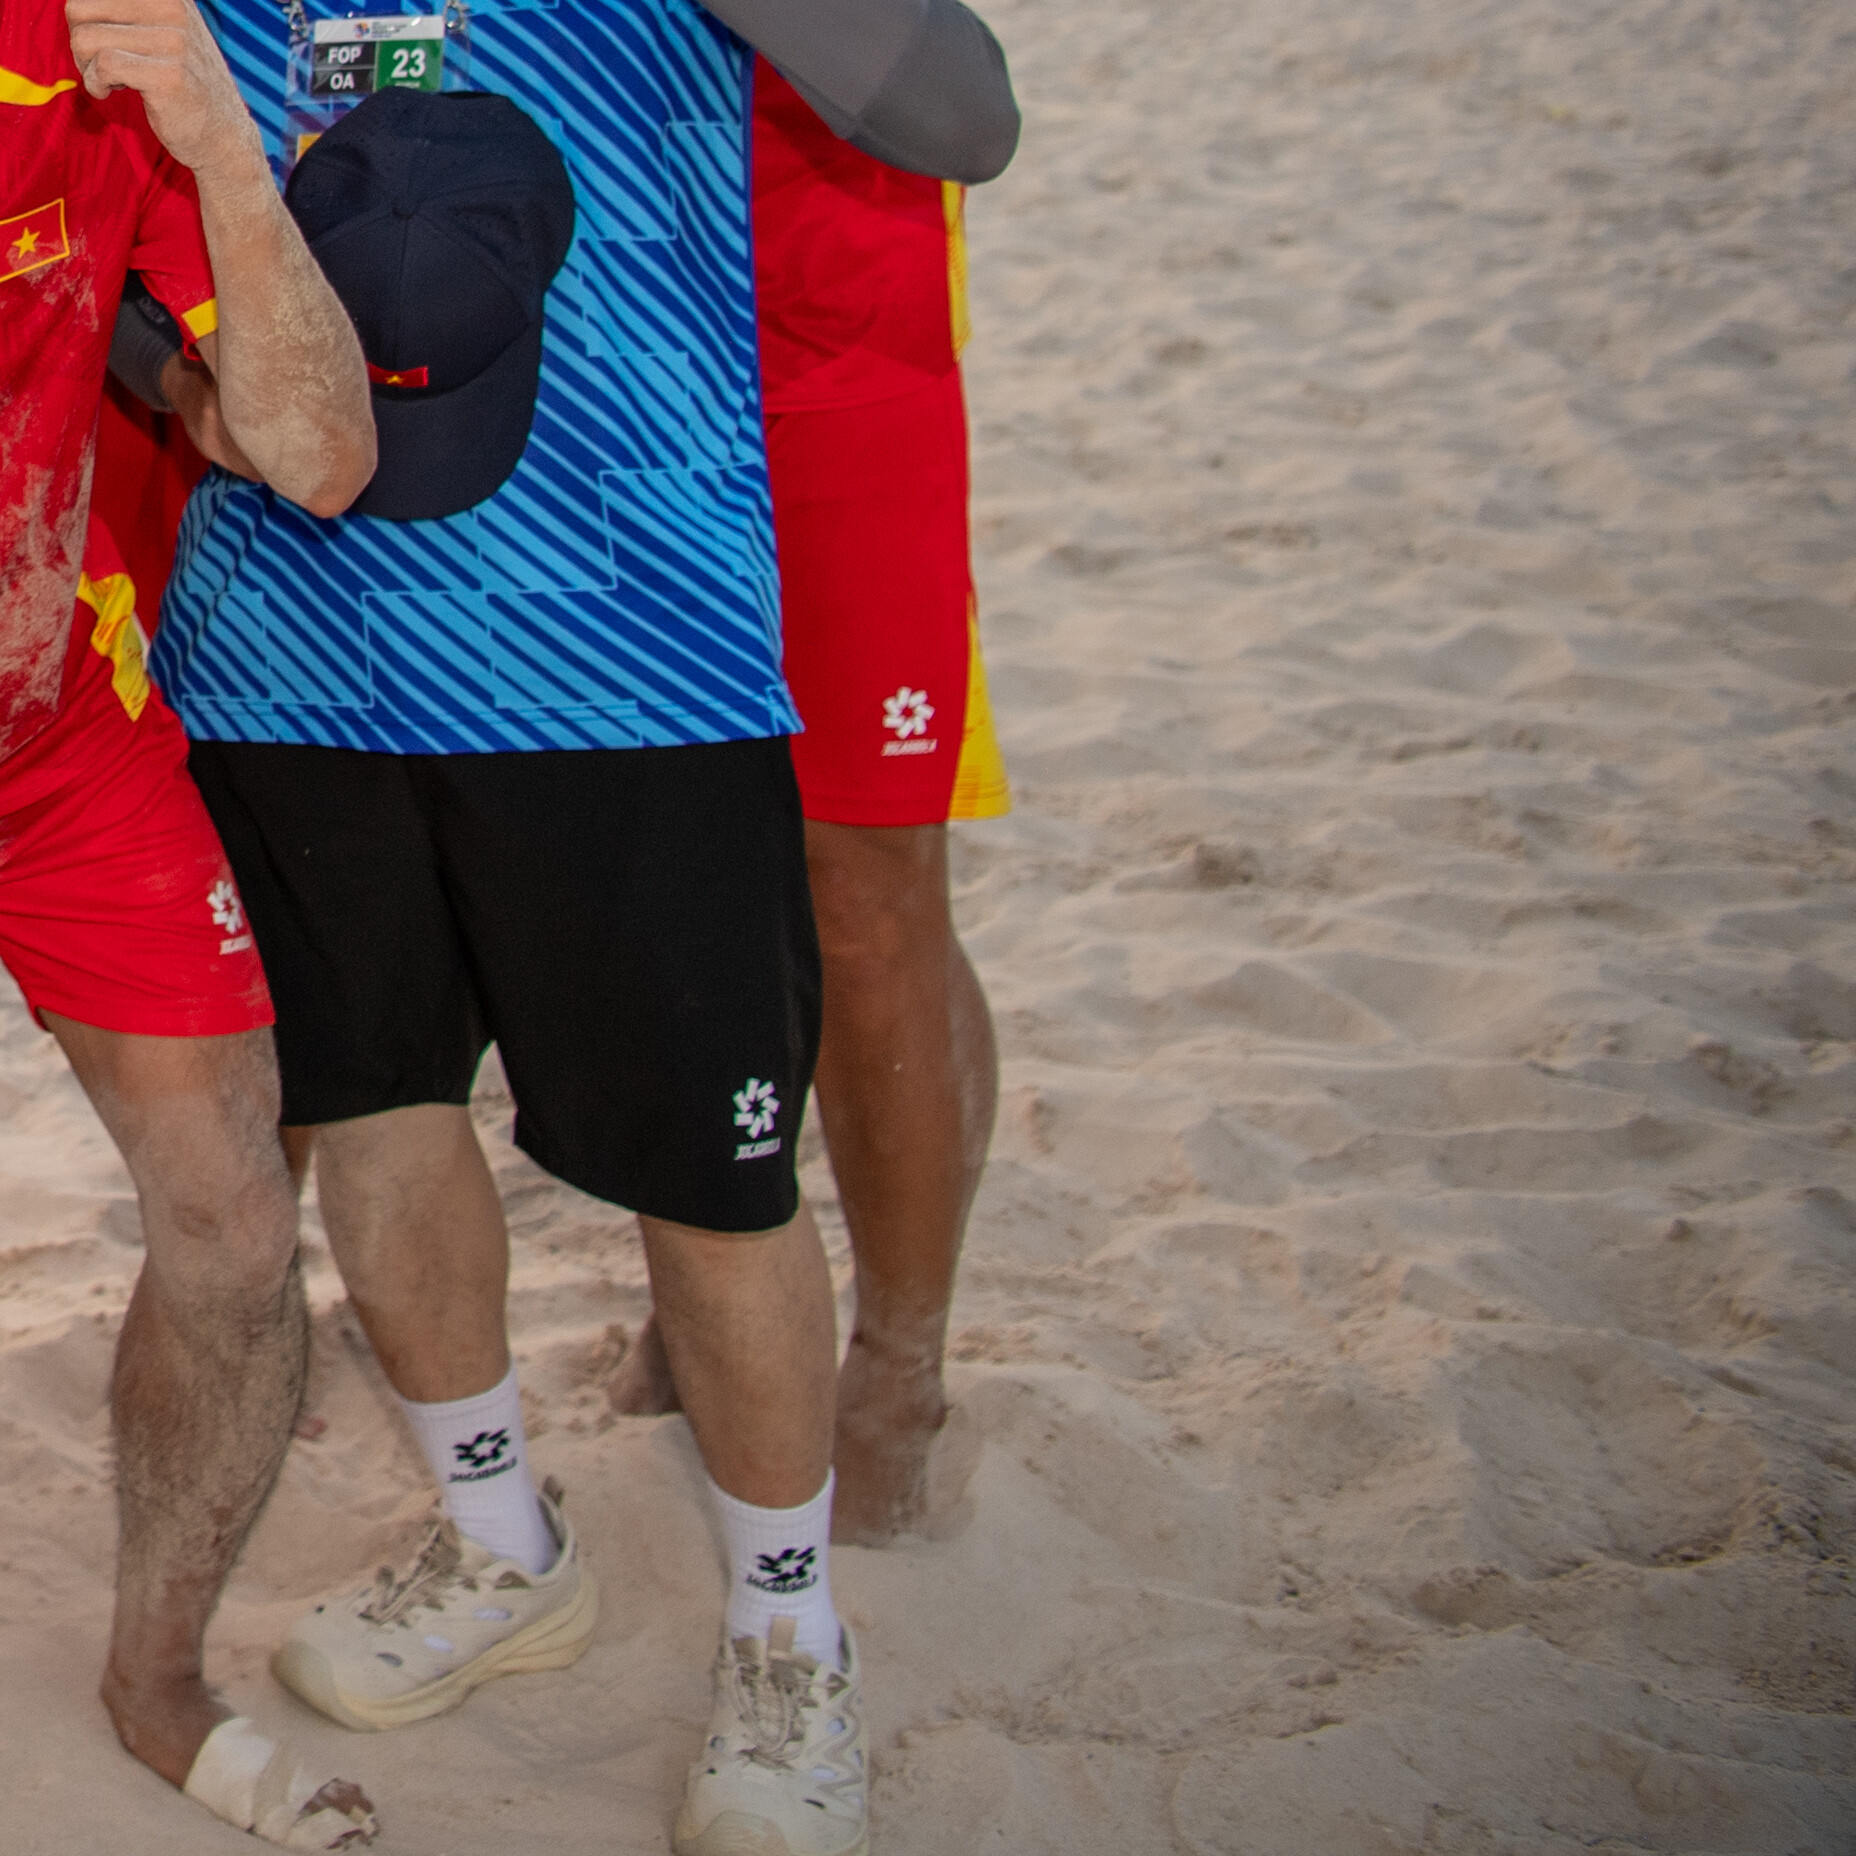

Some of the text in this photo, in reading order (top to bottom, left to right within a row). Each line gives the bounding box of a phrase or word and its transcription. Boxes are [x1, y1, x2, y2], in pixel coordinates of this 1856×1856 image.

[328, 45, 362, 64] FOP
[391, 48, 426, 78] 23
[330, 72, 355, 90] OA
